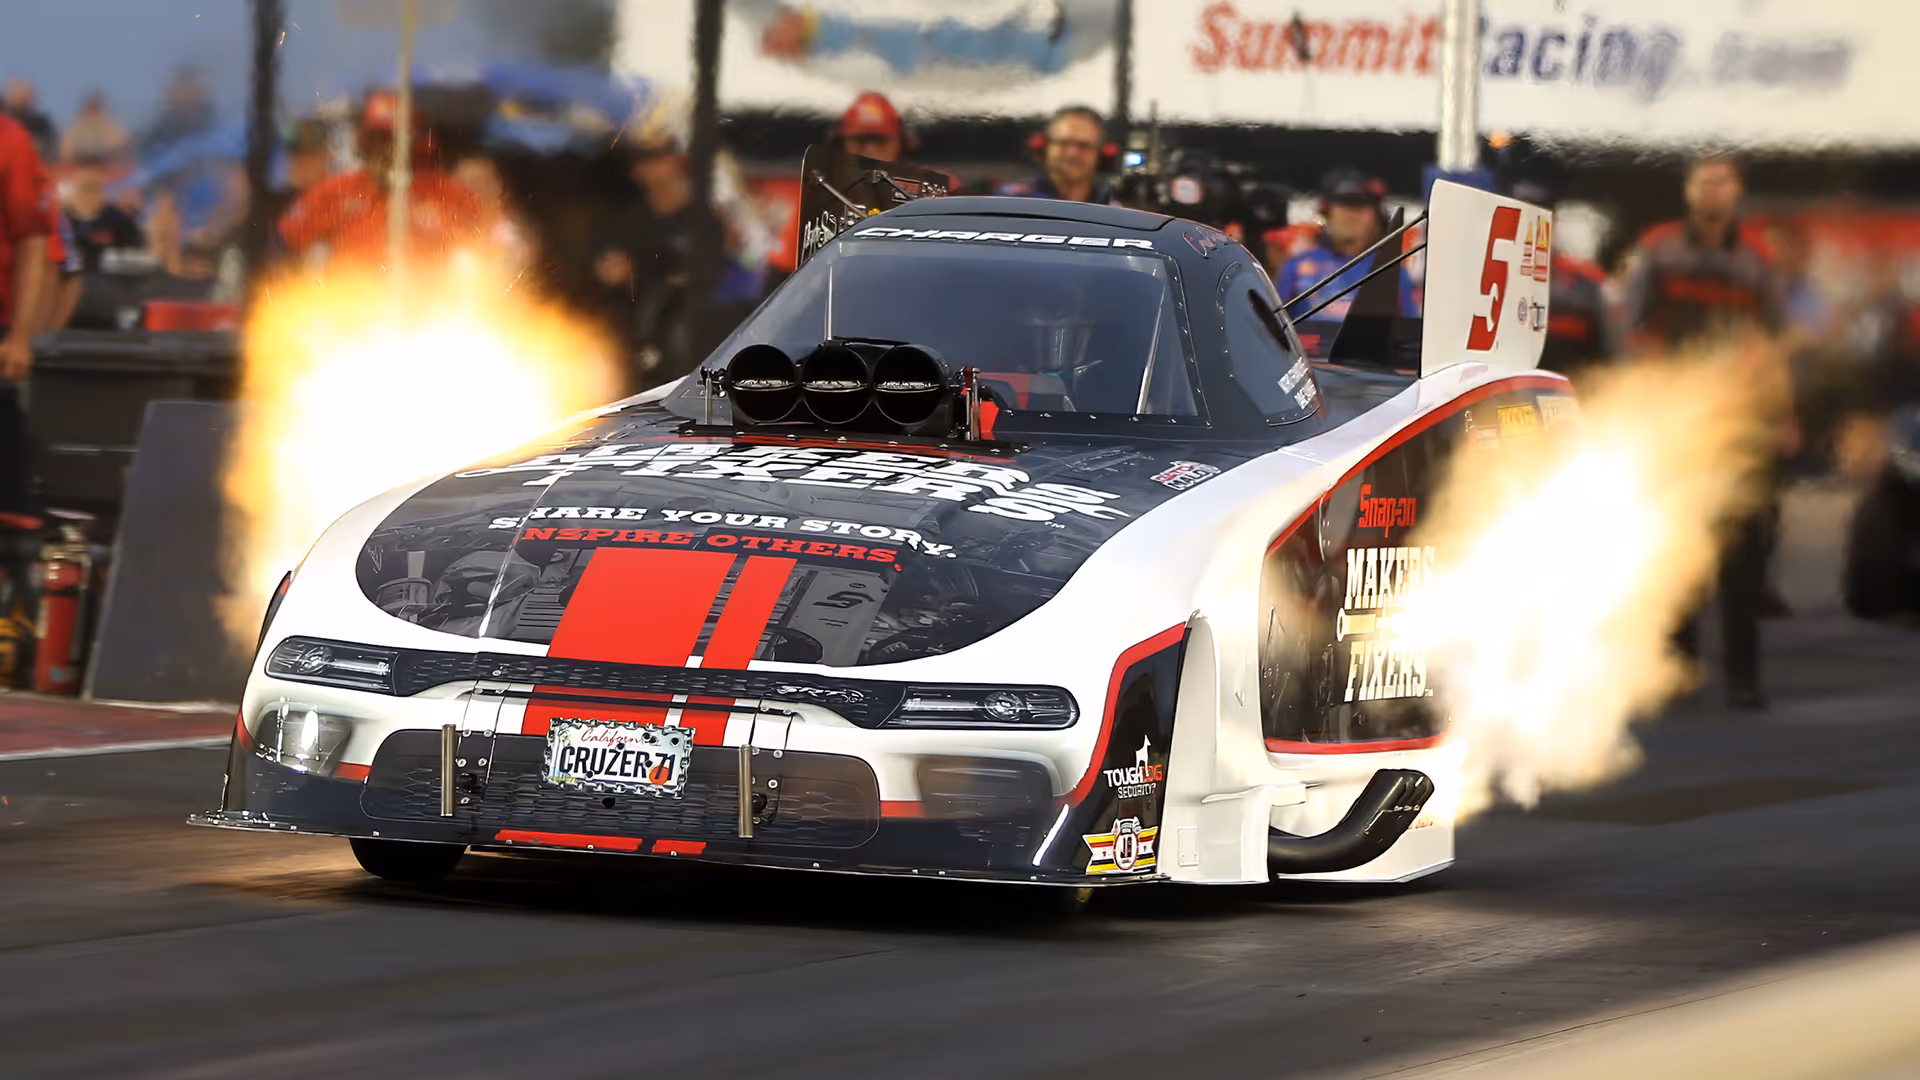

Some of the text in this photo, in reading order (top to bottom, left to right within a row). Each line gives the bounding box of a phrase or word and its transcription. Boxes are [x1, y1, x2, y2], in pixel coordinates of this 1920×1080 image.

[853, 226, 1155, 250] CHARGER
[1466, 206, 1522, 351] 5
[488, 506, 958, 559] SHARE YOUR STORY.
[1358, 484, 1418, 539] Snap-on
[508, 527, 695, 549] NSPIRE
[559, 745, 676, 781] CRUZER 71
